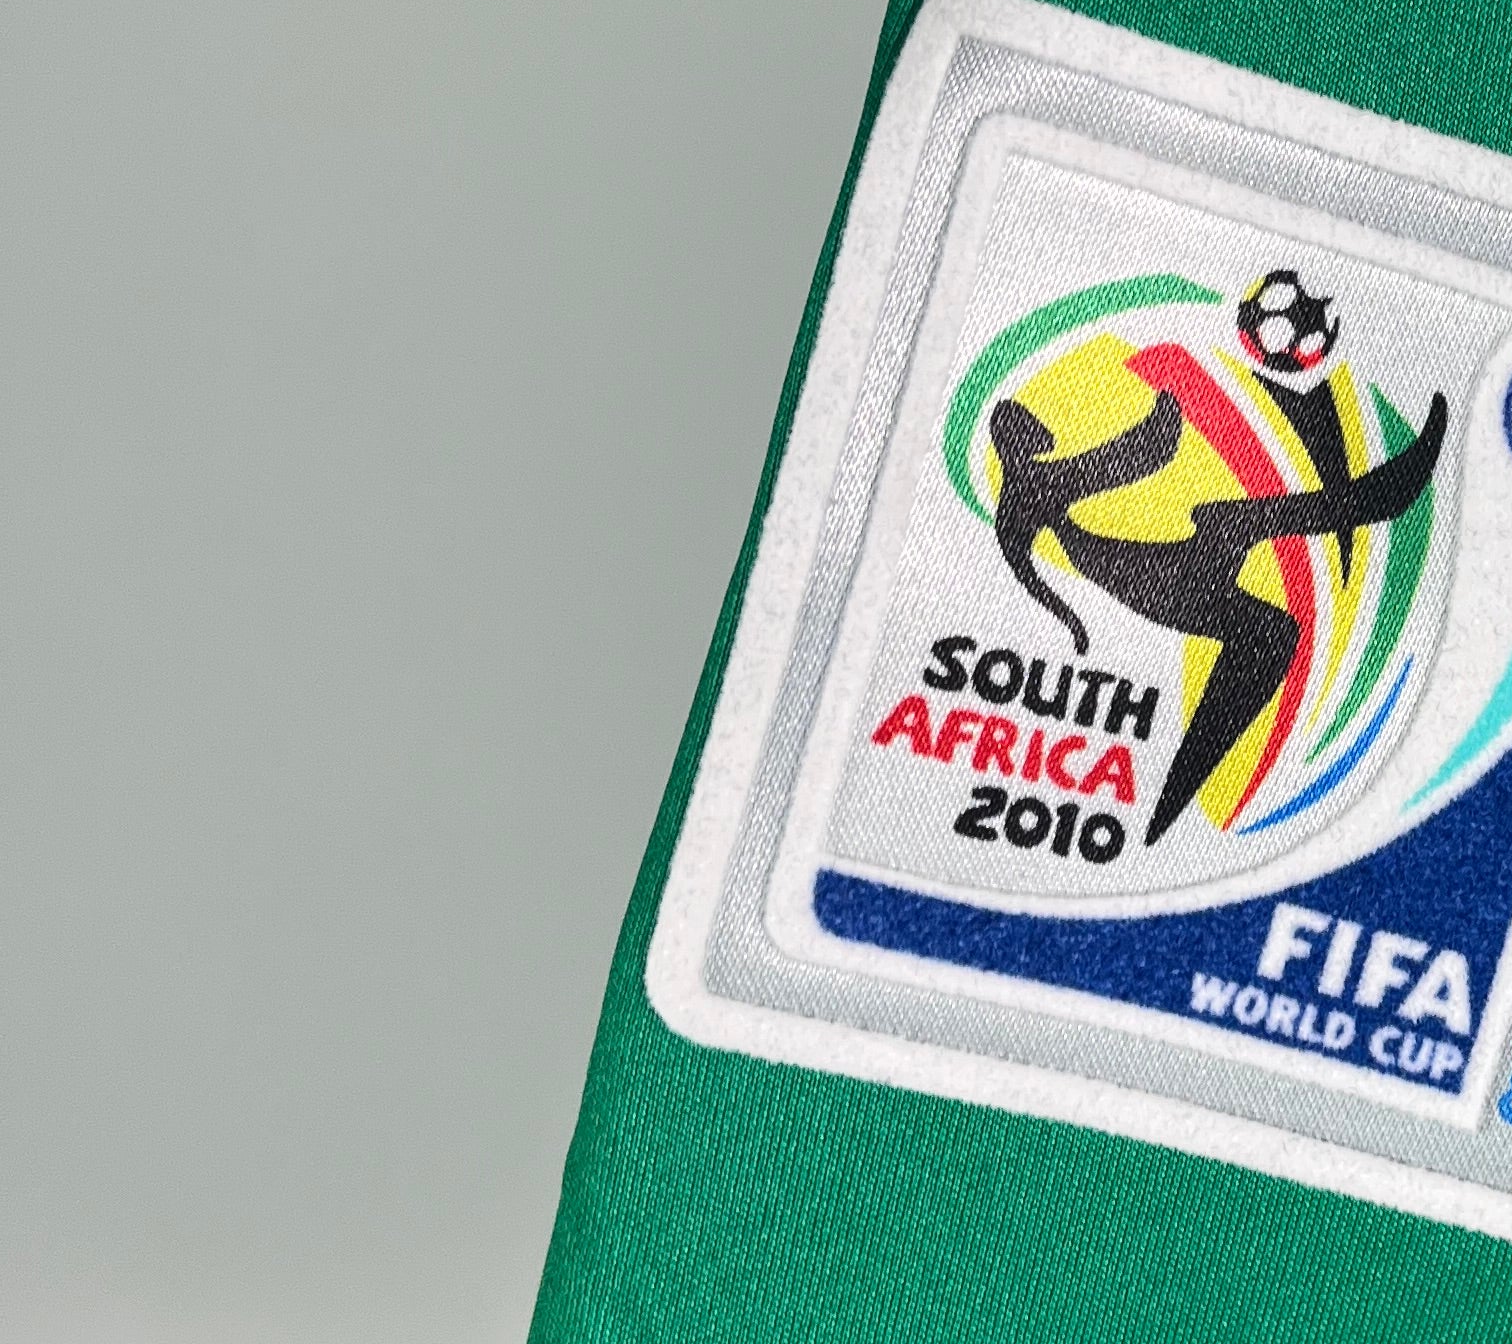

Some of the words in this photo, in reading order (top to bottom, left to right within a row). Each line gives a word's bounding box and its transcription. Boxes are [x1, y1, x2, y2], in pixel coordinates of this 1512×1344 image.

[923, 635, 1159, 741] SOUTH
[871, 695, 1136, 805] AFRICA
[953, 786, 1126, 864] 2010
[1257, 902, 1471, 1036] FIFA
[1190, 972, 1356, 1050] WORLD
[1369, 1026, 1464, 1080] CUP
